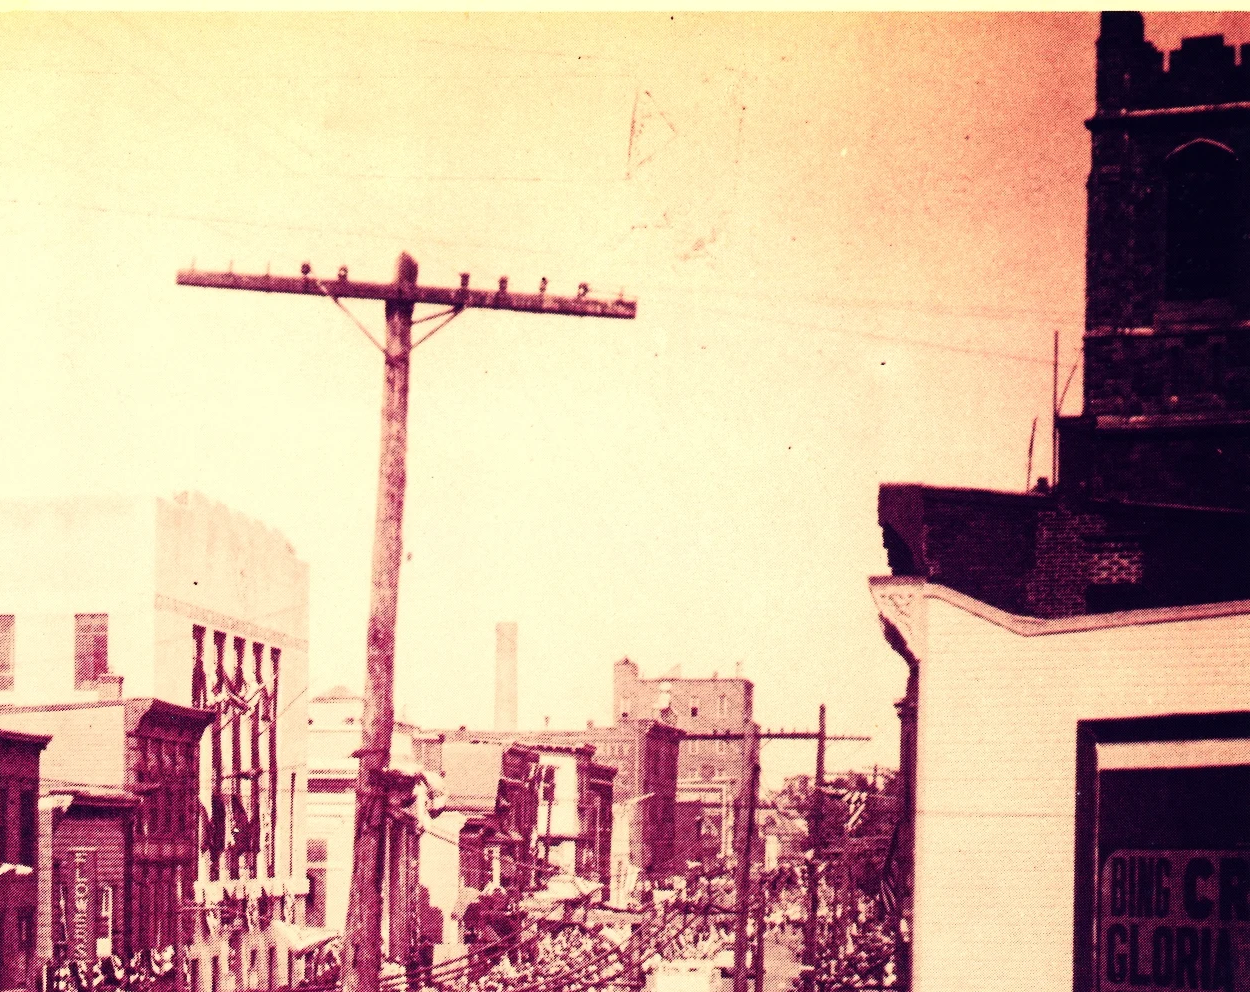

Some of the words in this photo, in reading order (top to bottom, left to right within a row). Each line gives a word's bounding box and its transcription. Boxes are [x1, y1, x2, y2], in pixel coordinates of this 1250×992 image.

[74, 852, 89, 958] FLOWERS
[1111, 856, 1172, 918] BING
[1106, 922, 1235, 992] GLORIA
